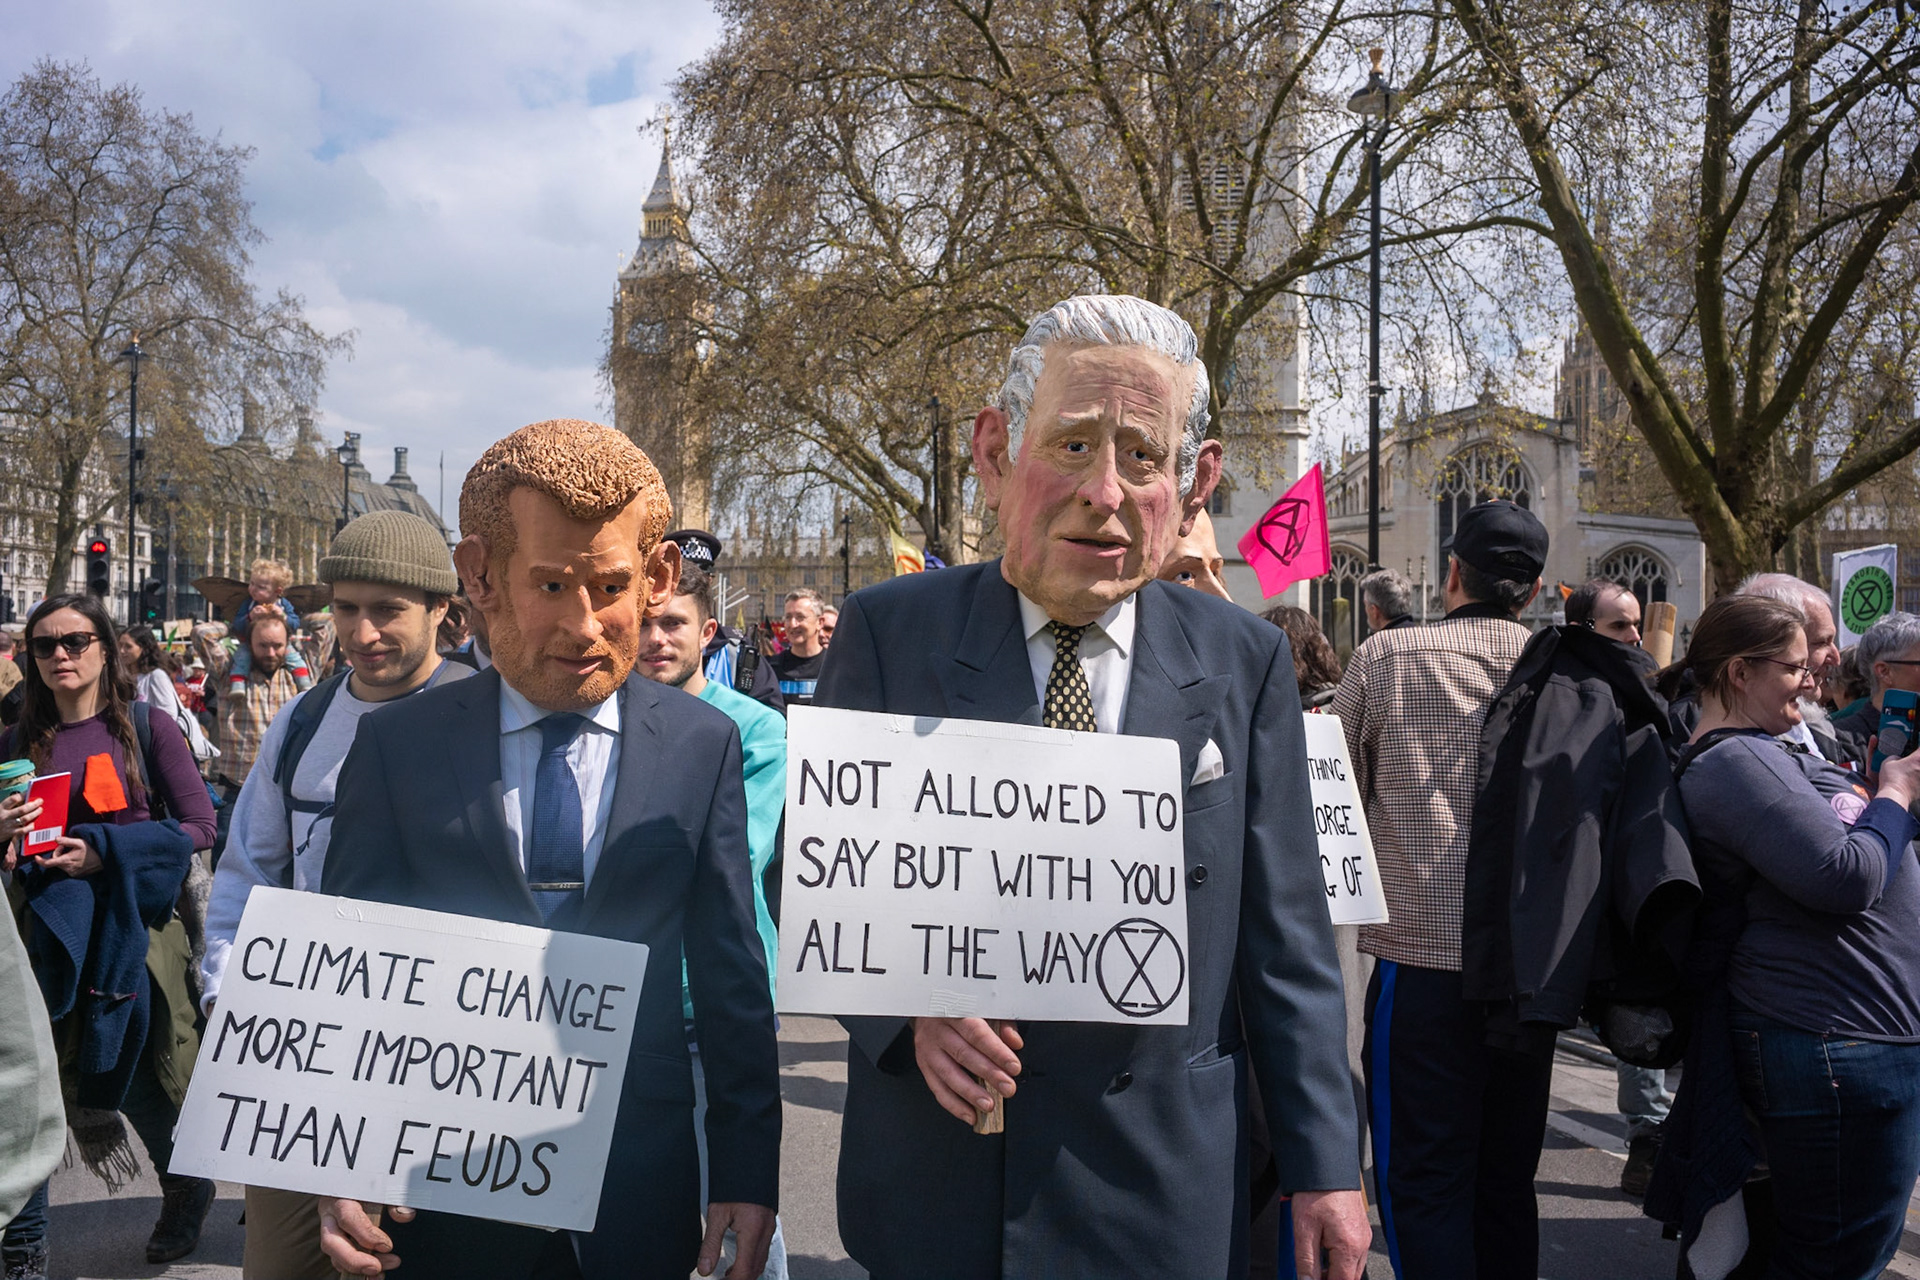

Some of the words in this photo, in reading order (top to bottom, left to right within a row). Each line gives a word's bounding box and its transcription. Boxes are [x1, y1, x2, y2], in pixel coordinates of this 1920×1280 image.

[799, 759, 892, 808] NOT
[914, 768, 1106, 825] ALLOWED
[1123, 789, 1177, 832] TO
[1315, 804, 1357, 836] ORGE
[797, 836, 880, 888] SAY
[893, 843, 972, 891] BUT
[991, 849, 1091, 901] WITH
[1110, 859, 1176, 905] YOU
[1342, 856, 1363, 897] OF
[242, 936, 435, 1006] CLIMATE
[457, 966, 626, 1032] CHANGE
[796, 919, 886, 974] ALL
[912, 923, 999, 980] THE
[1018, 930, 1099, 985] WAY
[212, 1010, 342, 1075] MORE
[352, 1029, 607, 1113] IMPORTANT
[217, 1092, 366, 1170] THAN
[389, 1120, 559, 1196] FEUDS
